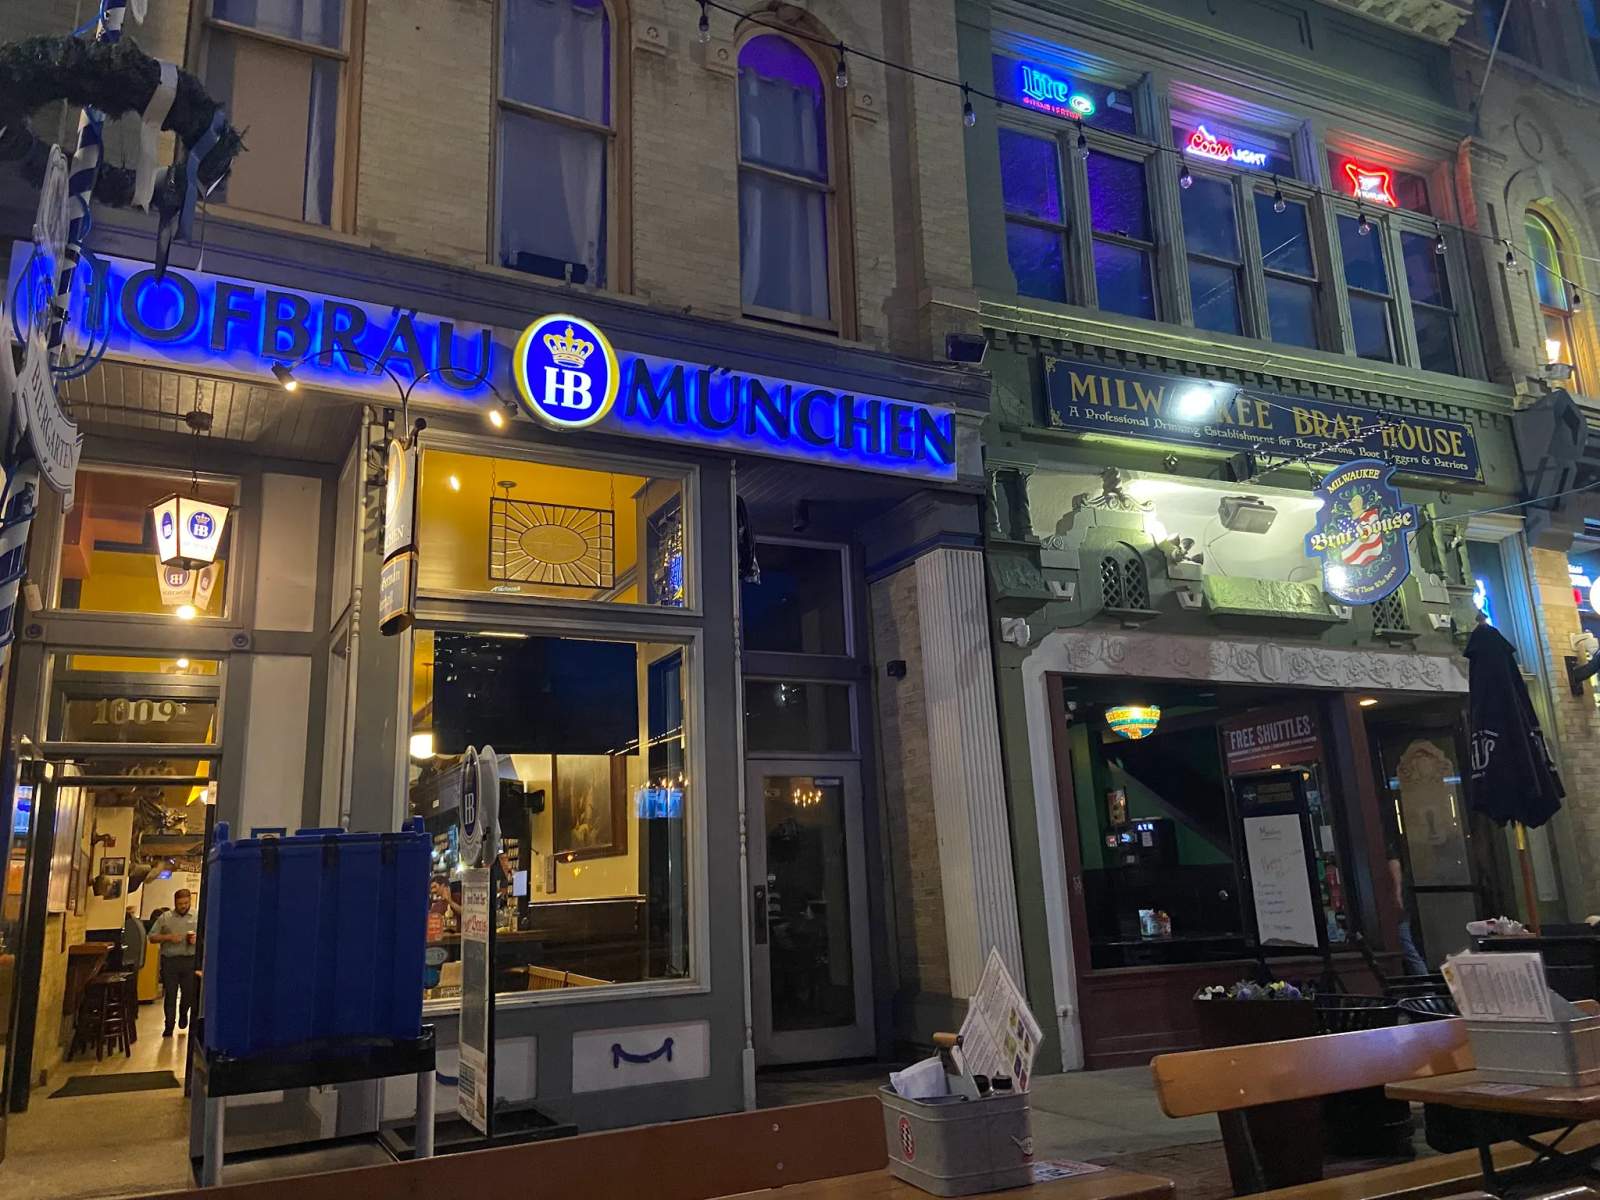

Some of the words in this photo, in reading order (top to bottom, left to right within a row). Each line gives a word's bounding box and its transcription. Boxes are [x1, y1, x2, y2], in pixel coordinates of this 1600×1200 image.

[1022, 65, 1068, 102] Lite
[1190, 133, 1232, 160] Coors
[543, 366, 592, 409] HB
[624, 358, 956, 464] MÜNCHEN
[1068, 371, 1273, 430] MILWKEE
[1292, 406, 1364, 443] BRAT
[1379, 419, 1466, 458] HOUSE
[1069, 406, 1080, 417] A
[1085, 407, 1150, 427] Professional
[1204, 424, 1275, 444] Establishment
[1278, 436, 1292, 447] for
[1296, 438, 1317, 450] Beer
[1359, 446, 1381, 459] Boot
[1383, 450, 1418, 466] Lggers
[1421, 455, 1431, 465] &
[1433, 457, 1469, 471] Patriots
[1327, 468, 1381, 494] MILWAUKEE
[93, 697, 177, 725] 1009
[1230, 727, 1255, 750] FREE
[1256, 715, 1311, 744] SHUTTLES
